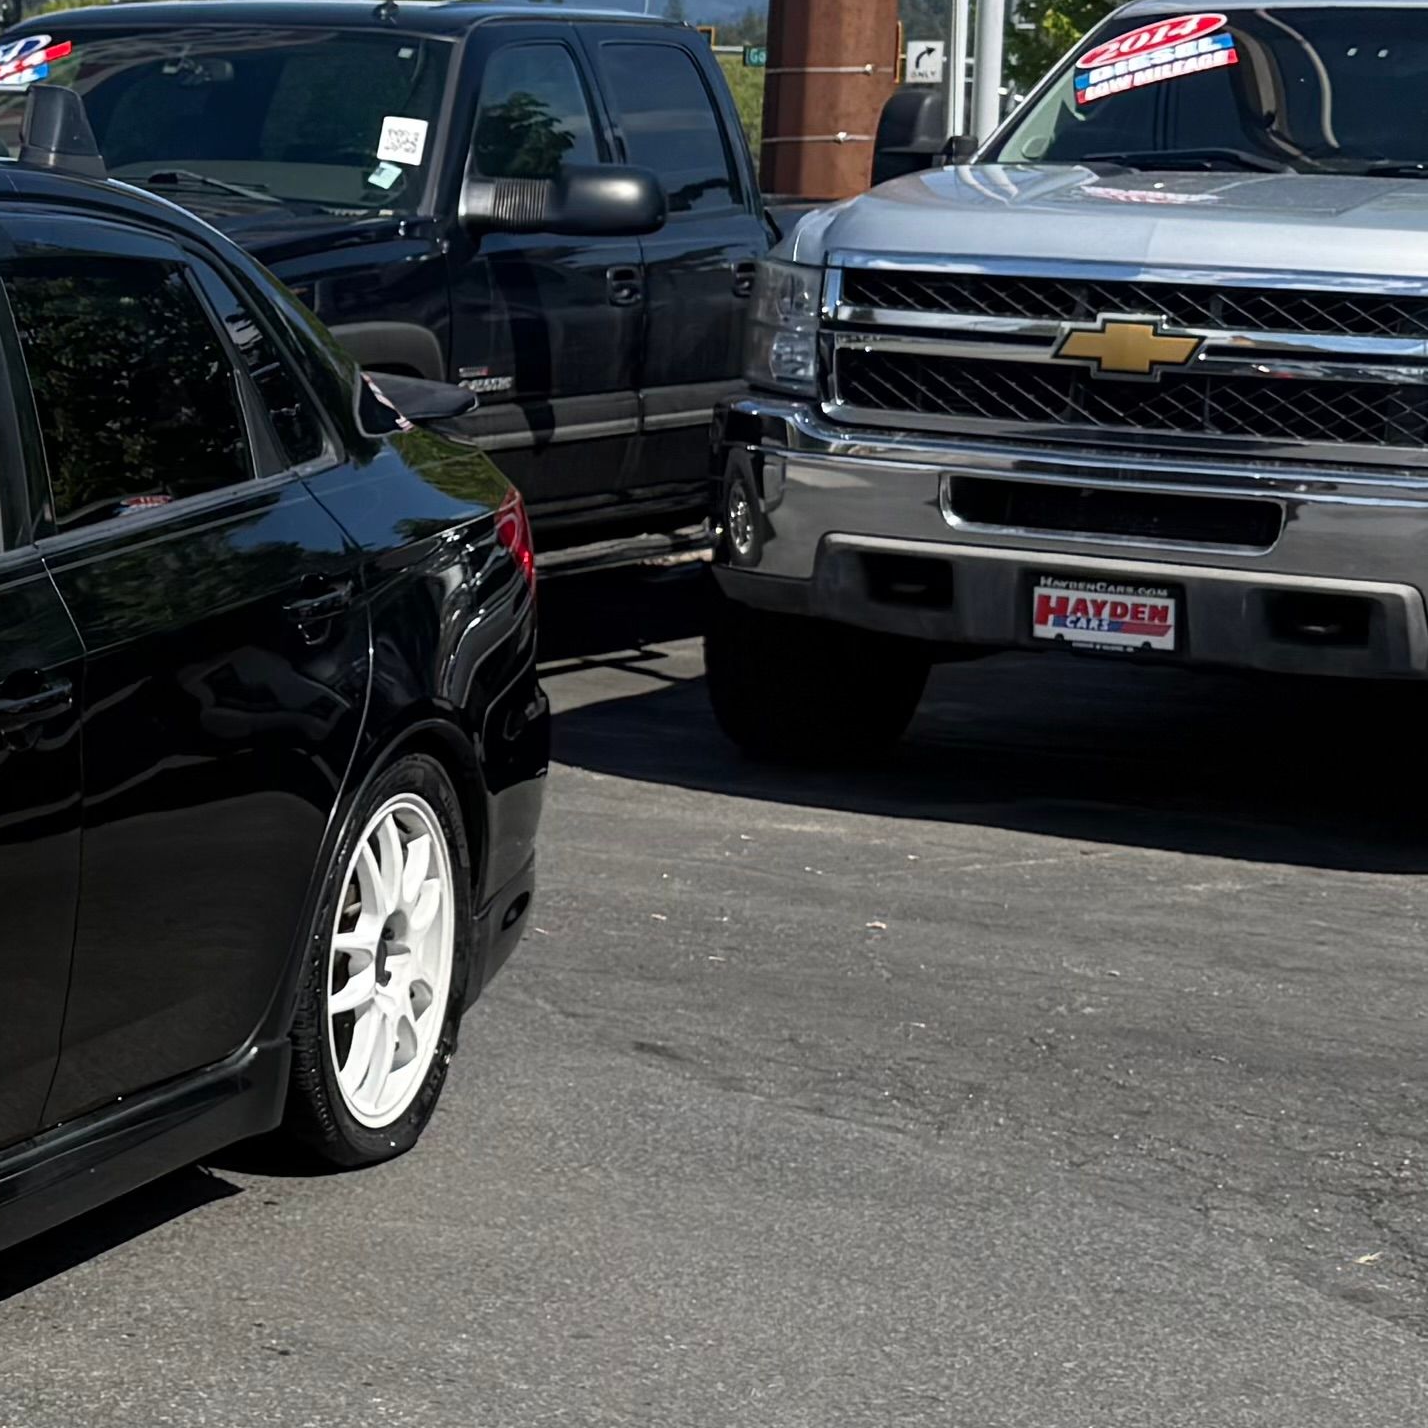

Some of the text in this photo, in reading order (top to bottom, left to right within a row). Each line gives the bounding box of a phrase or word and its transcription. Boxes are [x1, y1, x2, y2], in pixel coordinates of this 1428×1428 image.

[1096, 15, 1201, 62] 2014
[1088, 37, 1223, 85] DIESEL
[1133, 49, 1230, 87] MILEAGE
[1034, 594, 1170, 626] HAYDEN
[1065, 616, 1110, 631] CARS
